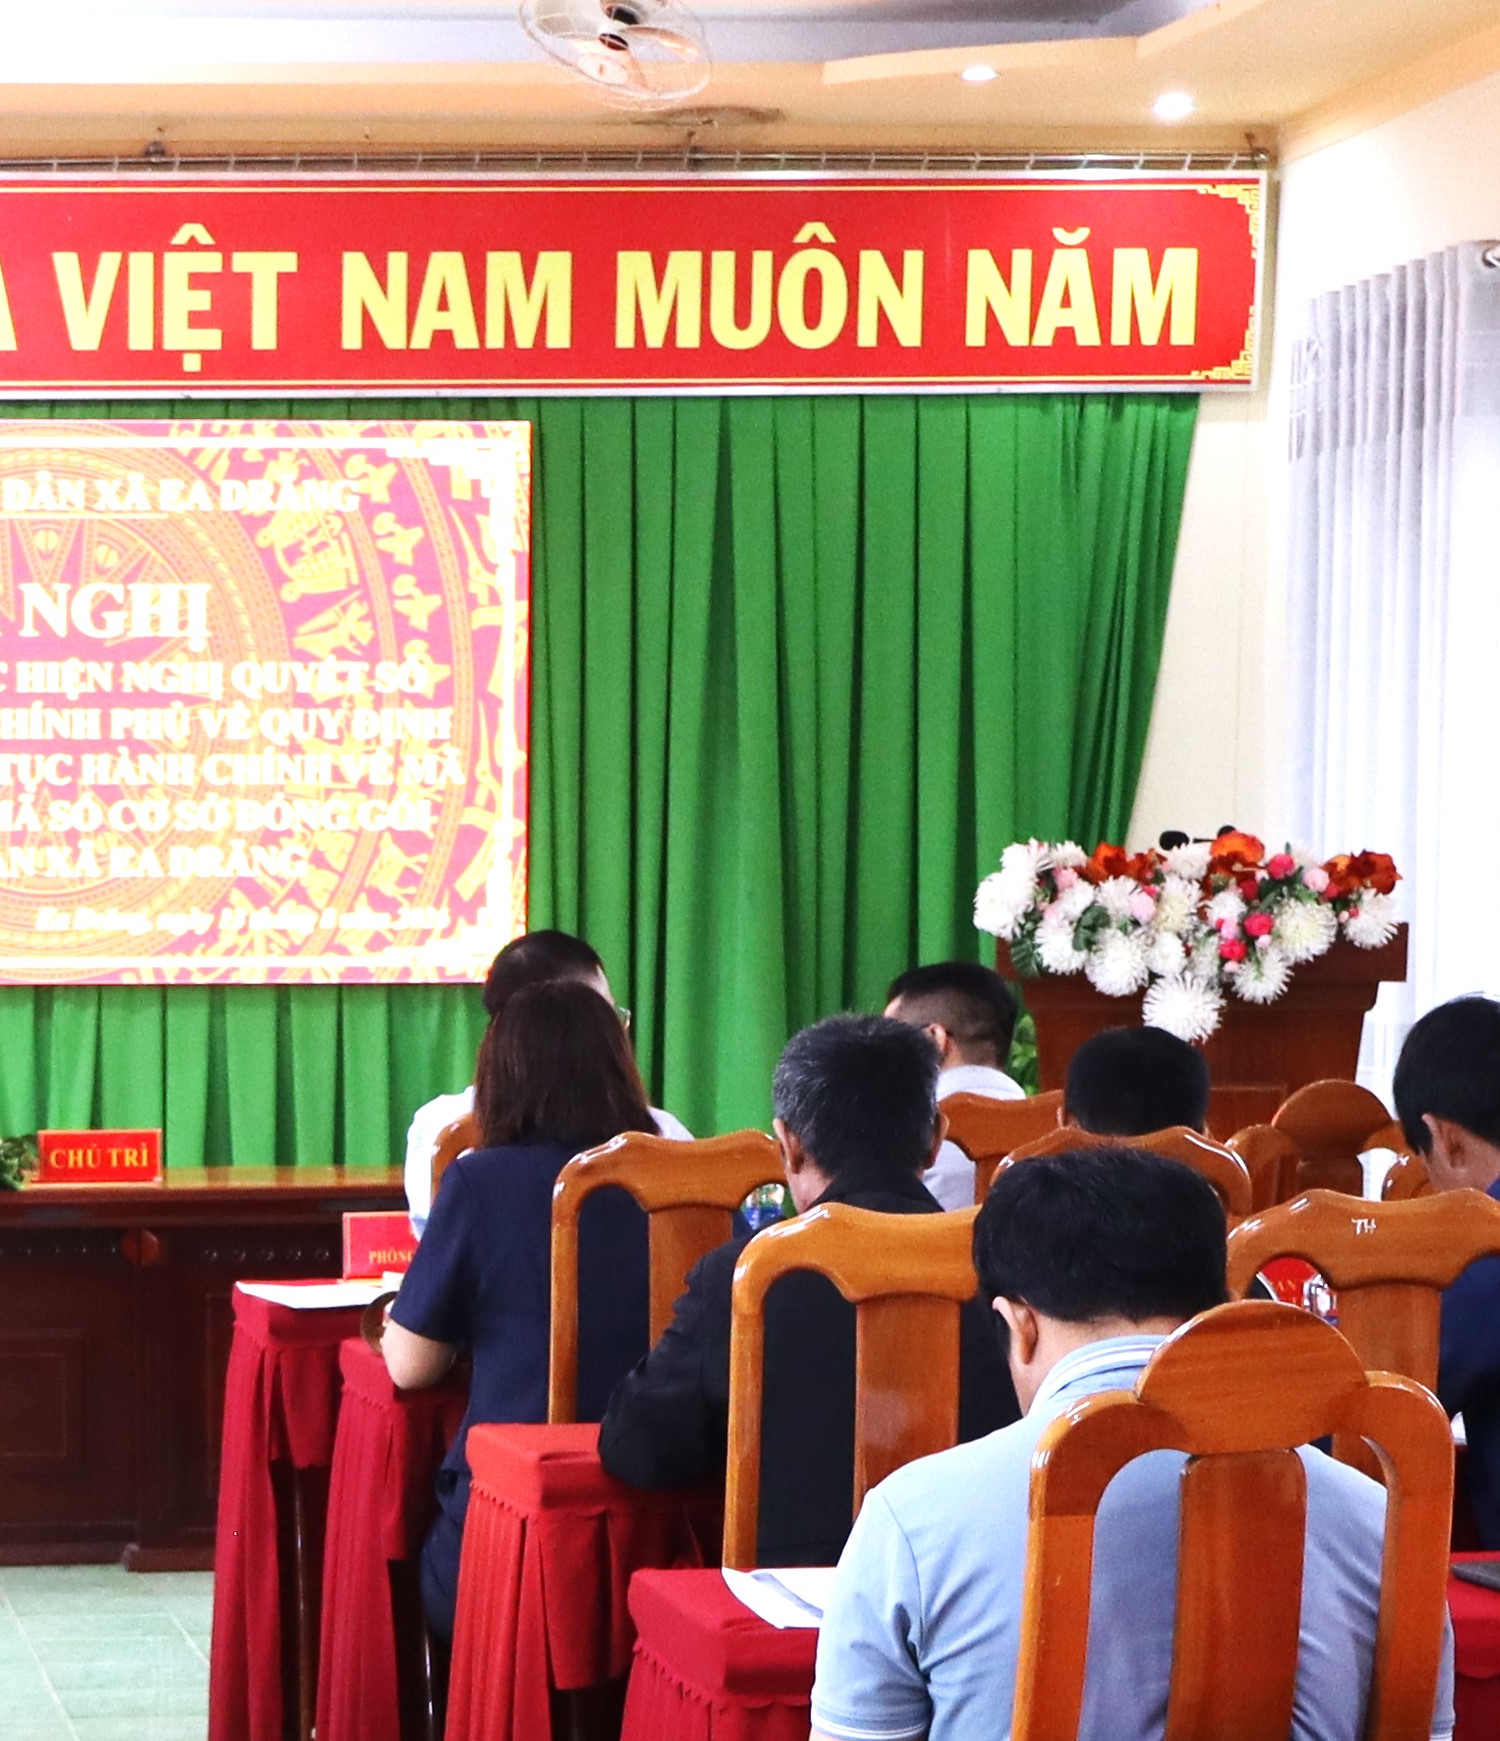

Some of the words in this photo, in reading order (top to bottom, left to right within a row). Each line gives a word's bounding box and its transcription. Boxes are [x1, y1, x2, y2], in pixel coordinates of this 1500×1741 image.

[52, 222, 298, 372] VIỆT
[342, 251, 571, 350] NAM
[616, 222, 923, 349] MUÔN
[966, 227, 1198, 347] NĂM
[3, 470, 84, 511] DÂN
[95, 473, 151, 511] XÃ
[159, 479, 213, 512] EA
[221, 473, 360, 512] DRĂNG
[18, 582, 212, 653] NGHỊ
[16, 657, 114, 700] HIỆN
[123, 661, 223, 700] NGHỊ
[111, 702, 188, 740] PHỦ
[259, 708, 344, 746] QUY
[352, 708, 451, 746] ĐỊNH
[82, 746, 195, 786] HÀNH
[202, 747, 332, 786] CHÍNH
[402, 748, 466, 785] MÃ
[108, 798, 169, 832] CƠ
[356, 793, 433, 832] GÓI
[44, 840, 101, 878] XÃ
[109, 847, 163, 878] EA
[49, 1142, 101, 1168] CHỦ
[107, 1141, 150, 1167] TRÌ
